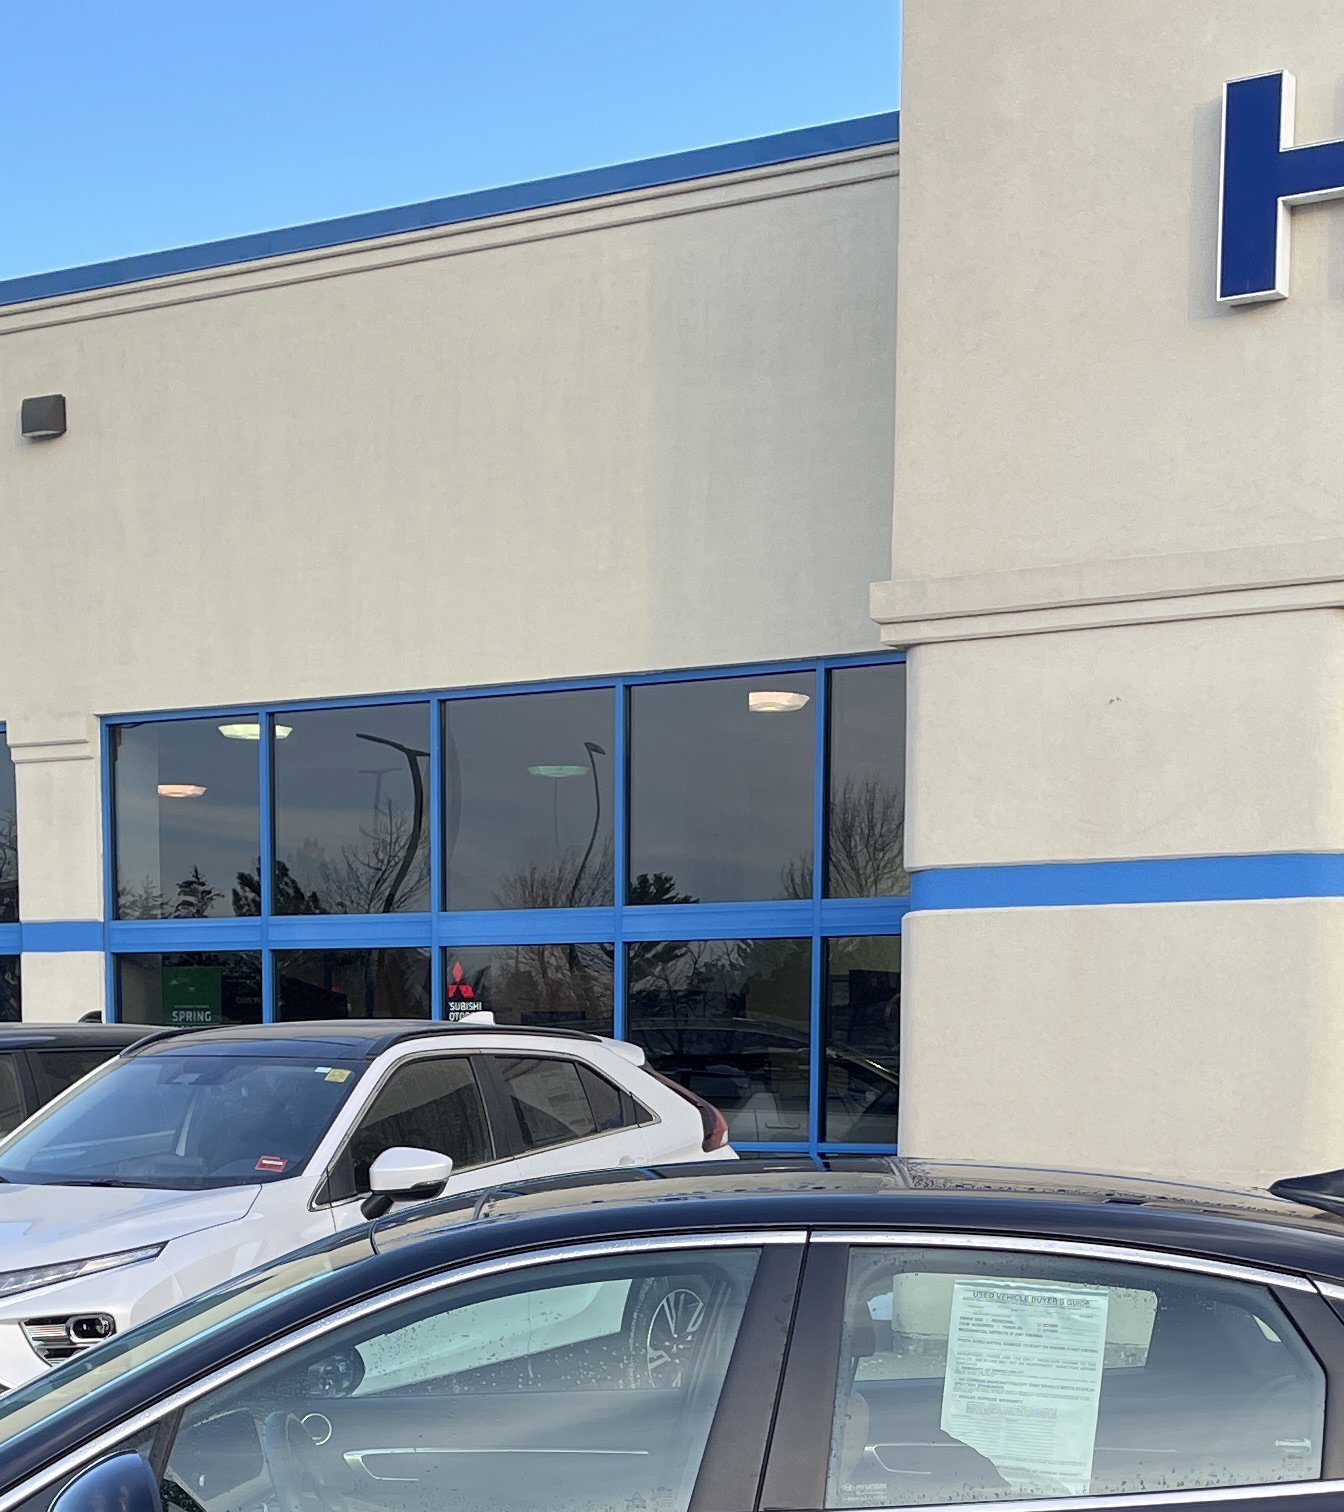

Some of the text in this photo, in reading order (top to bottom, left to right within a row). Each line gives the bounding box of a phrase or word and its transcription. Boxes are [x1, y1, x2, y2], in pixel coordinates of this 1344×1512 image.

[448, 1001, 483, 1011] SUBISHI
[172, 1010, 212, 1022] SPRING
[972, 1290, 994, 1299] USED
[996, 1292, 1029, 1303] VEHICLE
